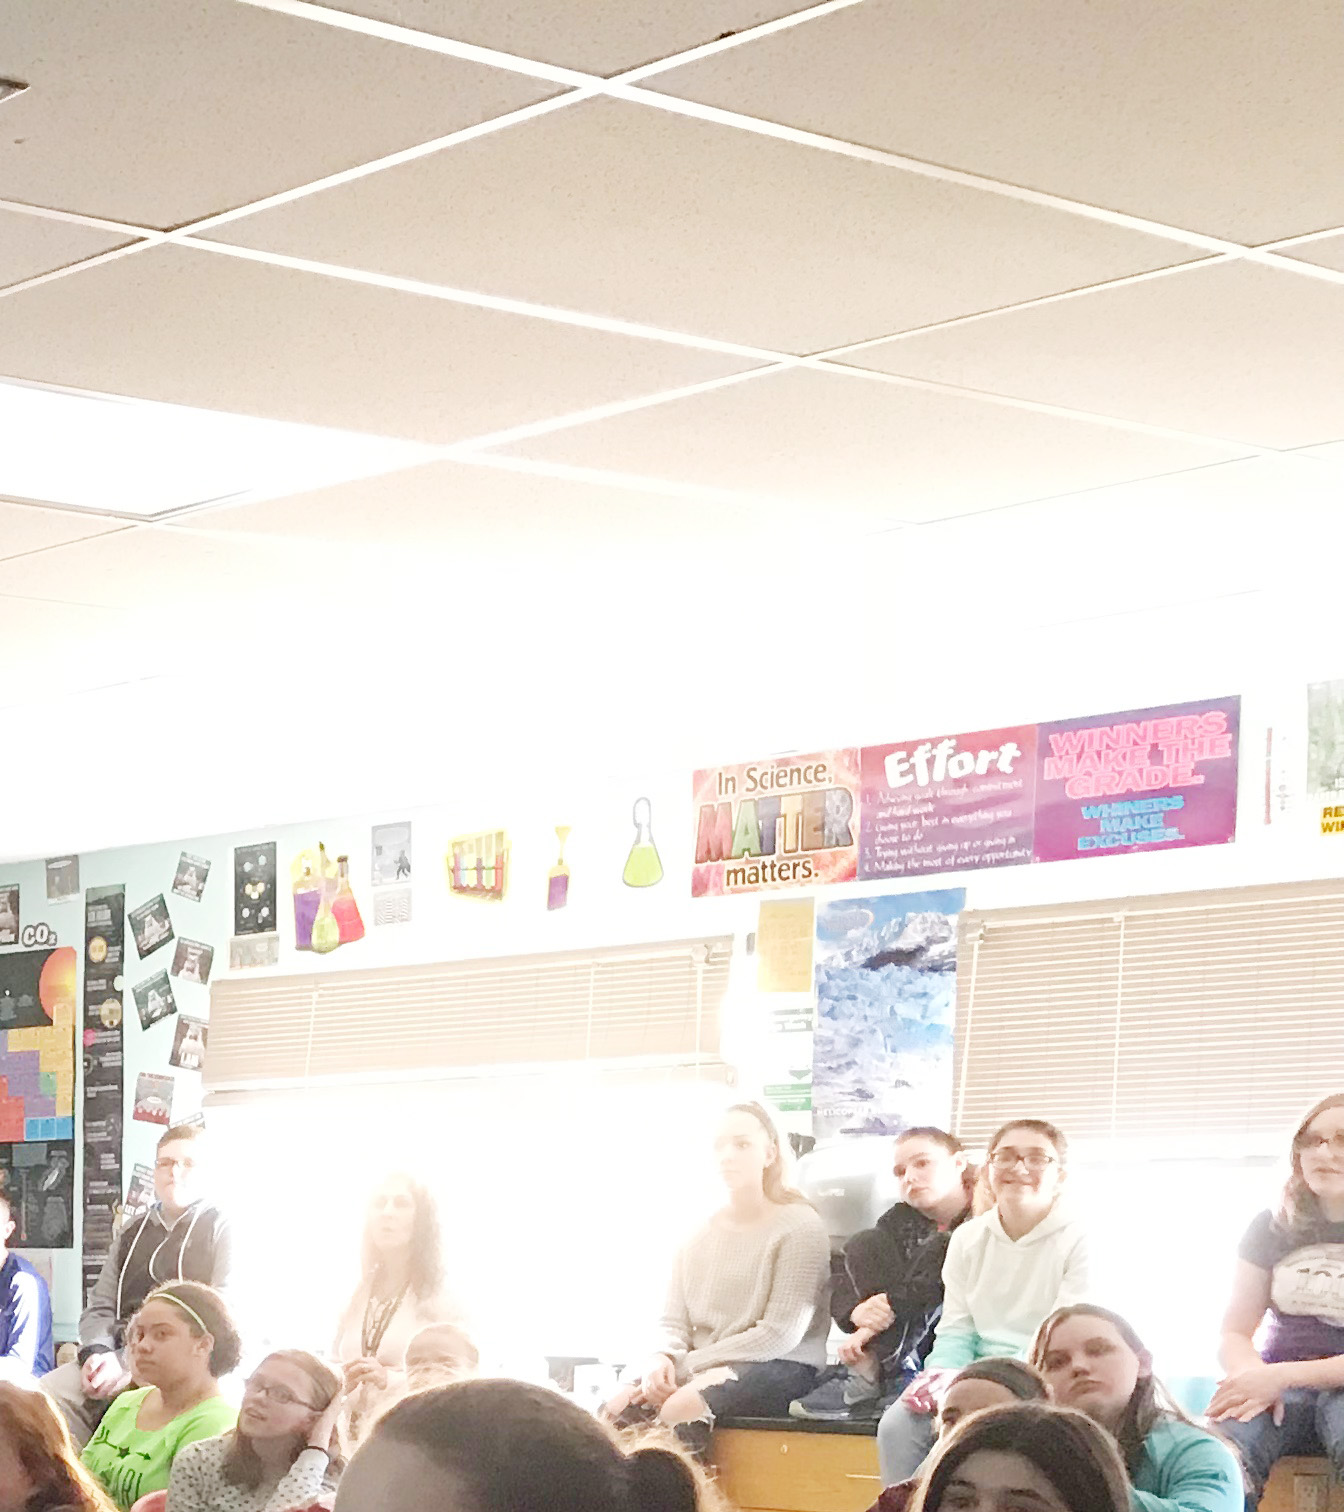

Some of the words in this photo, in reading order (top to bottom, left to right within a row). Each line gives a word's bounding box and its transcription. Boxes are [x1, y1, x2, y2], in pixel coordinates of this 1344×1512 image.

[1049, 710, 1228, 757] WINNERS
[884, 738, 1022, 789] Effort
[1044, 745, 1151, 780] MAKE
[1158, 733, 1232, 764] THE
[718, 772, 736, 795] In
[745, 763, 833, 793] Science,
[695, 786, 854, 864] MATTER
[1081, 795, 1184, 819] WHINERS
[1100, 812, 1164, 832] MAKE
[726, 859, 819, 888] matters.
